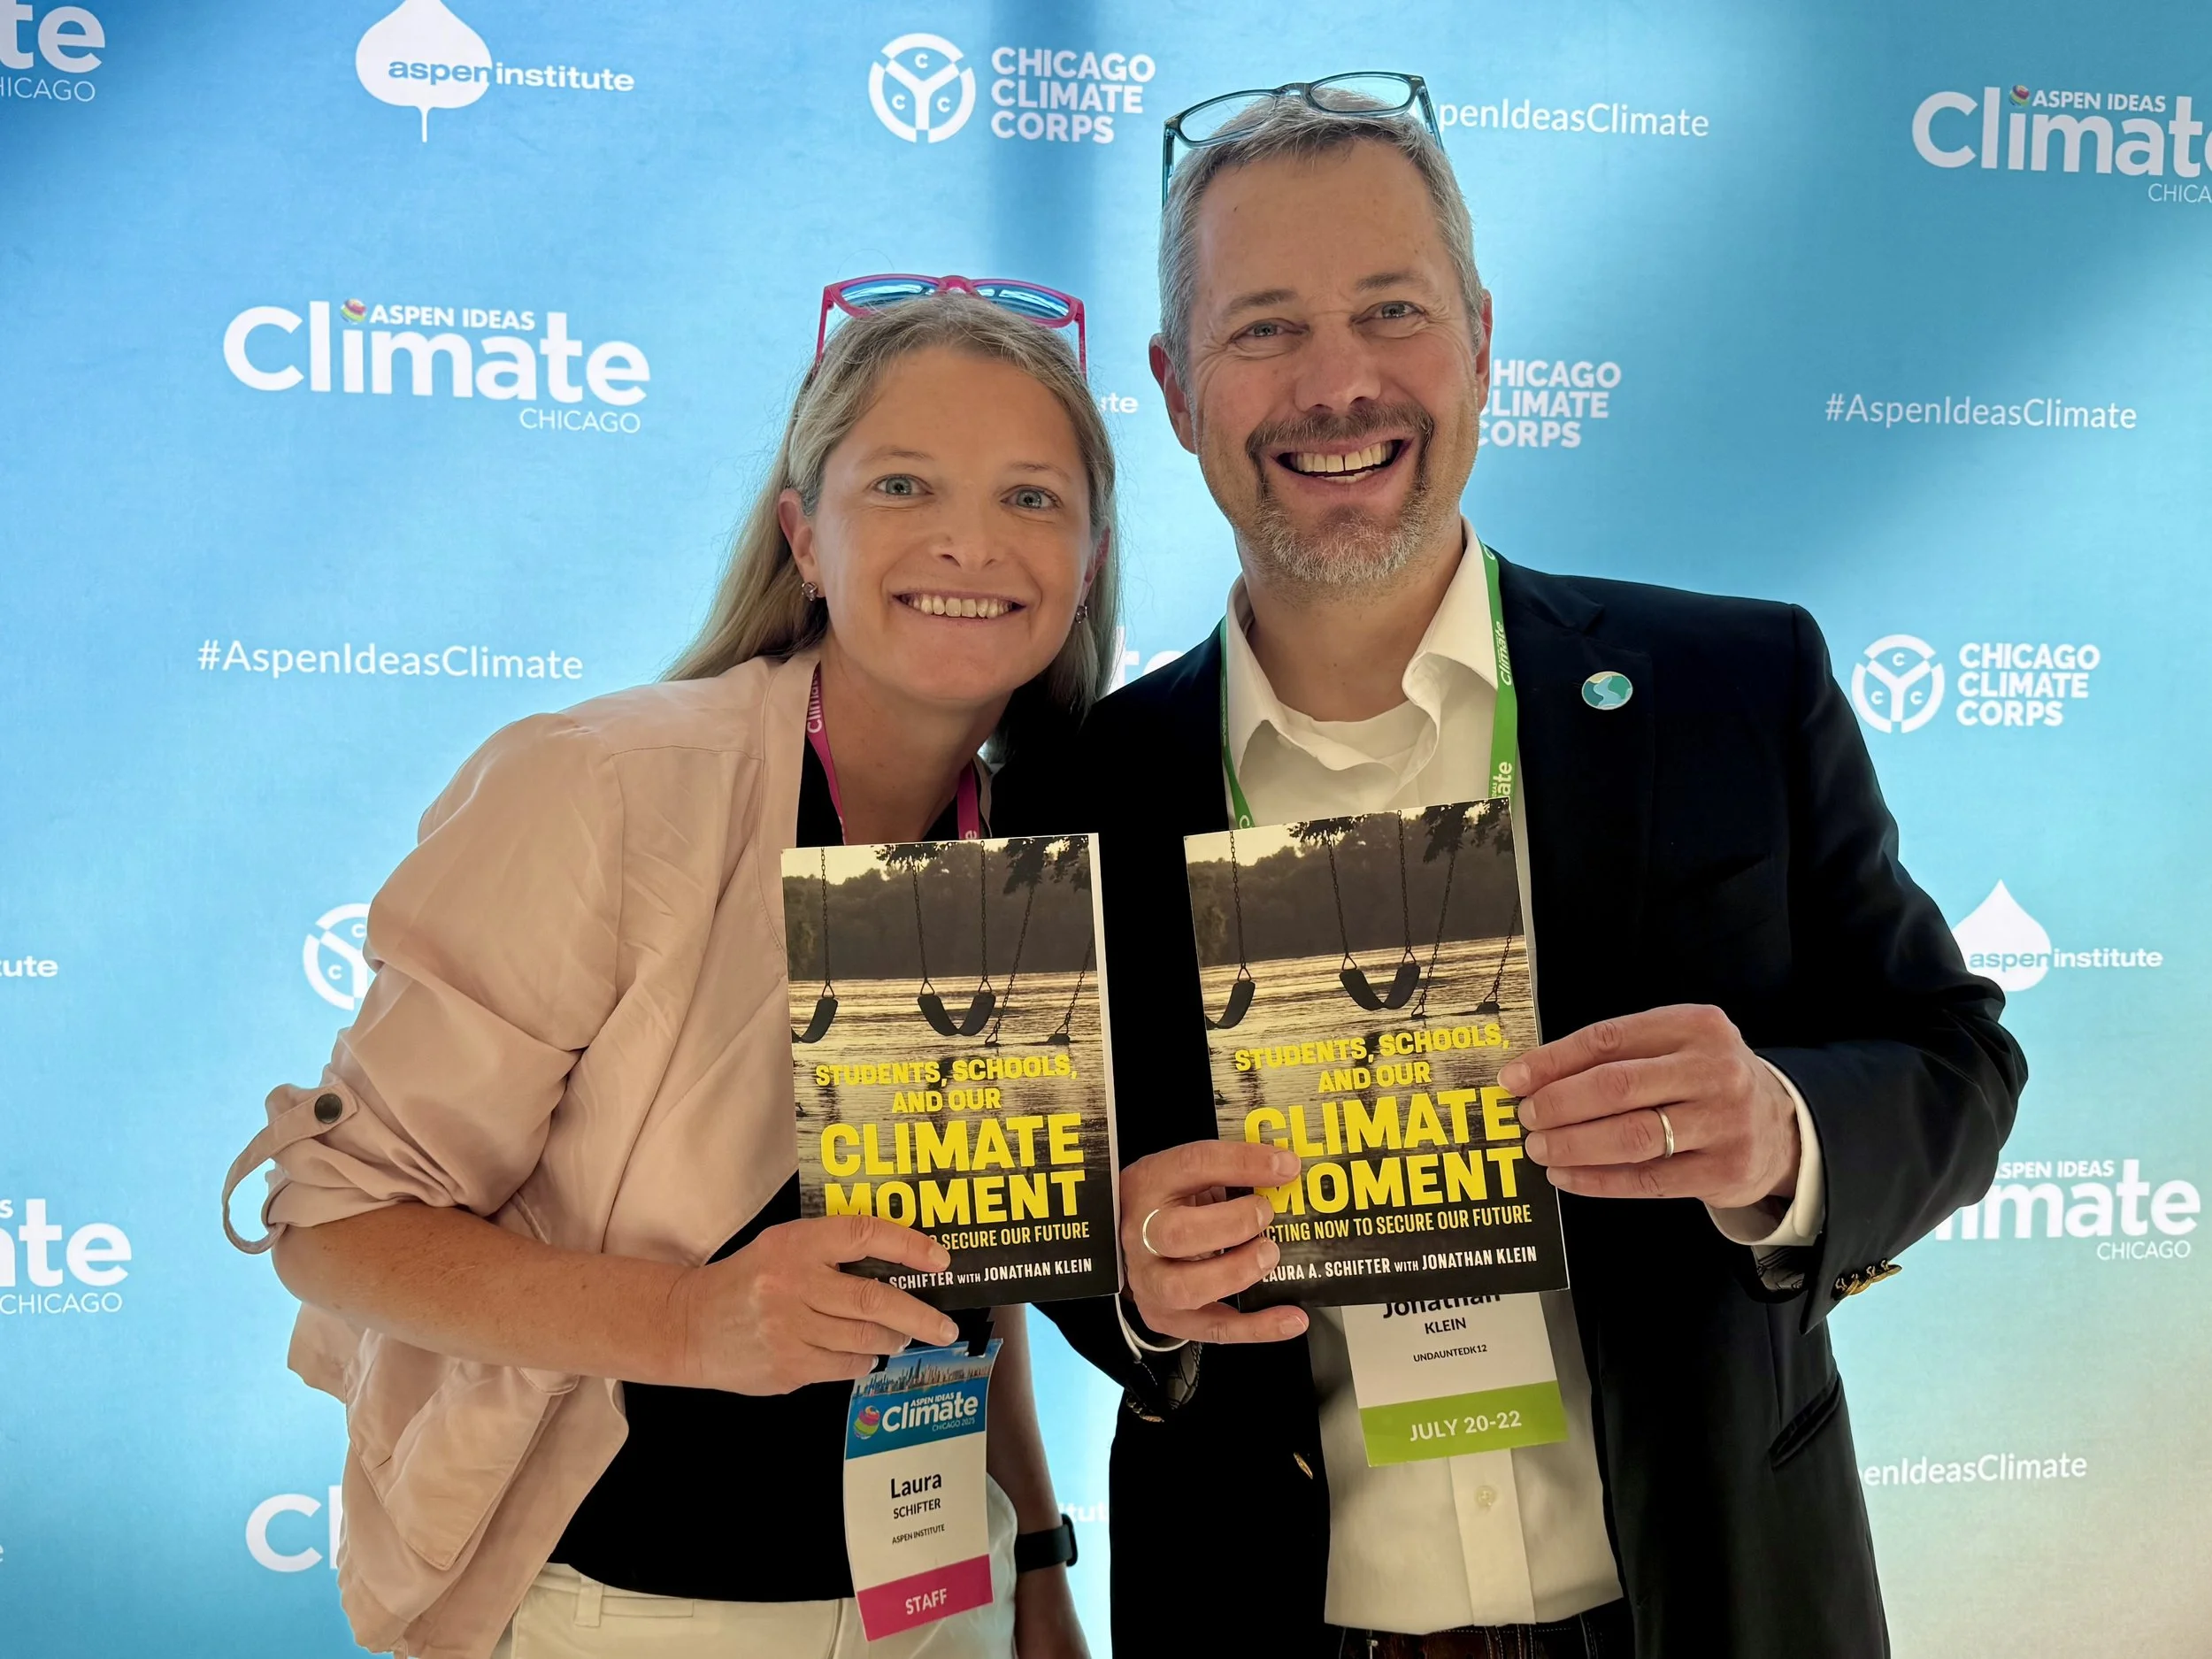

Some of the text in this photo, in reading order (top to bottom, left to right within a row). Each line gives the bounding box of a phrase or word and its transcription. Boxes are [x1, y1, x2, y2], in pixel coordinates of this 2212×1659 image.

[388, 61, 635, 92] aspen institute
[991, 47, 1156, 82] CHICAGO
[0, 76, 96, 103] ICAGO
[991, 79, 1144, 113] CLIMATE
[2032, 90, 2166, 112] ASPEN IDEAS
[990, 111, 1115, 144] CORPS
[1439, 98, 1709, 137] penIdeasClimate
[1912, 87, 2212, 178] Climat
[2147, 182, 2212, 203] CHICA
[369, 304, 535, 332] ASPEN IDEAS
[223, 300, 650, 406] Climate
[1493, 359, 1622, 388] HICAGO
[1480, 390, 1609, 418] LIMATE
[1825, 392, 2137, 431] #AspenIdeasClimate
[519, 408, 641, 434] CHICAGO
[197, 639, 584, 679] #AspenIdeasClimate
[1959, 642, 2101, 670] CHICAGO
[1957, 672, 2089, 698] CLIMATE
[1955, 700, 2063, 726] CORPS
[1969, 948, 2163, 972] aspen institute
[1235, 1024, 1509, 1071] STUDENTS, SCHOOLS,
[816, 1055, 1078, 1087] STUDENTS, SCHOOLS,
[1318, 1062, 1432, 1094] AND OUR
[892, 1087, 1002, 1113] AND OUR
[1244, 1086, 1522, 1158] CLIMATE
[820, 1112, 1085, 1177] CLIMATE
[2057, 1160, 2115, 1178] IDEAS
[825, 1171, 1087, 1229] MOMENT
[1935, 1158, 2201, 1240] mate
[942, 1230, 997, 1250] SECURE
[1002, 1227, 1031, 1245] OUR
[1035, 1222, 1090, 1241] FUTURE
[1259, 1205, 1532, 1242] CTING NOW TO SECURE OUR FUTURE
[1309, 1263, 1321, 1279] A.
[1325, 1257, 1391, 1277] SCHIFTER
[1394, 1260, 1418, 1272] WITH
[1422, 1249, 1494, 1271] JONATHAN
[1496, 1246, 1537, 1265] KLEIN
[2097, 1240, 2191, 1261] CHICAGO
[889, 1258, 1092, 1290] SCHIFTER WITH JONATHAN KLEIN
[0, 1292, 123, 1315] CHICAGO
[1425, 1317, 1467, 1334] KLEIN
[1413, 1344, 1487, 1362] UNDAUNTEDK12
[882, 1391, 979, 1432] Climate
[910, 1392, 955, 1408] ASPEN IDEAS
[932, 1419, 961, 1432] CHICAGO
[1410, 1409, 1523, 1442] JULY 20-22
[1858, 1452, 2087, 1486] enIdeasClimate
[890, 1473, 942, 1499] Laura
[893, 1498, 941, 1519] SCHIFTER
[892, 1524, 945, 1545] ASPEN INSTITUTE
[905, 1587, 948, 1615] STAFF
